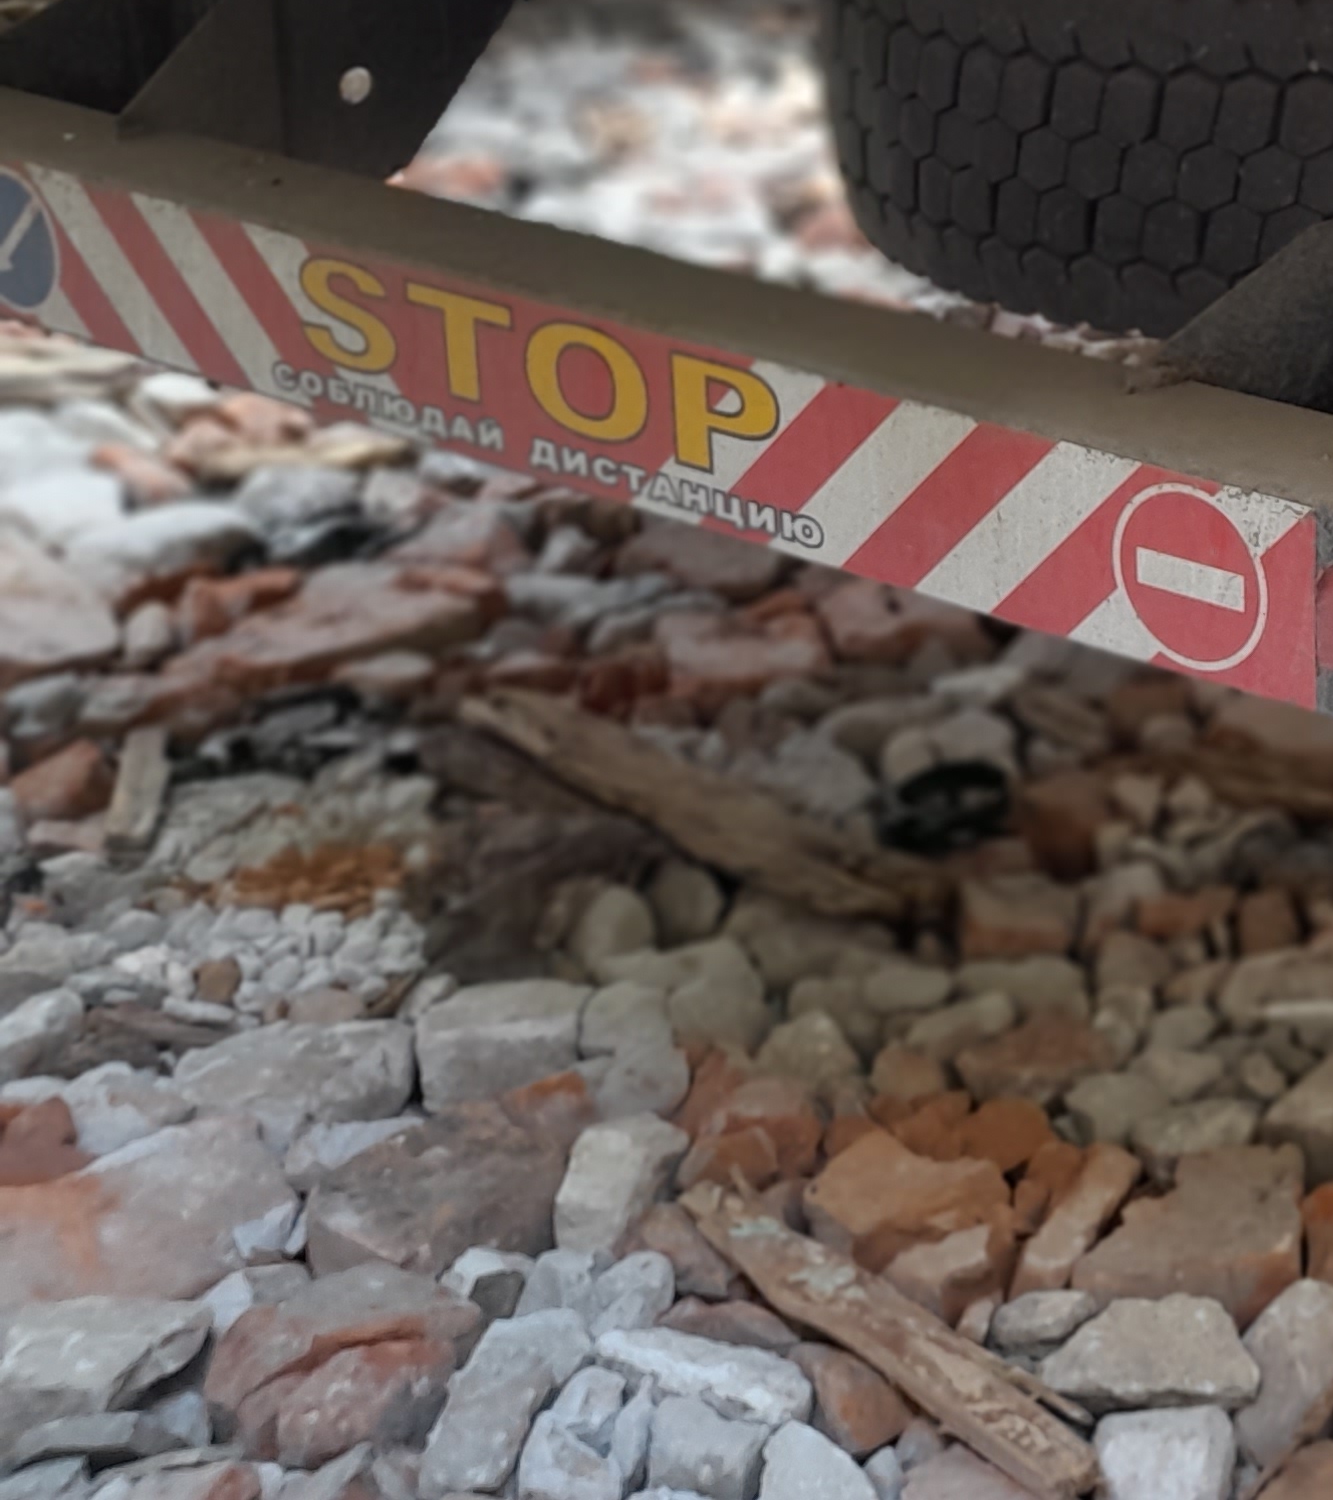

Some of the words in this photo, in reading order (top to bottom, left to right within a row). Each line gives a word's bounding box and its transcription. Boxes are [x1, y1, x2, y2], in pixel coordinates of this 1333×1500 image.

[273, 361, 504, 451] СОБЛЮДАЙ
[530, 437, 825, 549] ДИСТАНЦИЮ
[299, 255, 780, 474] STOP
